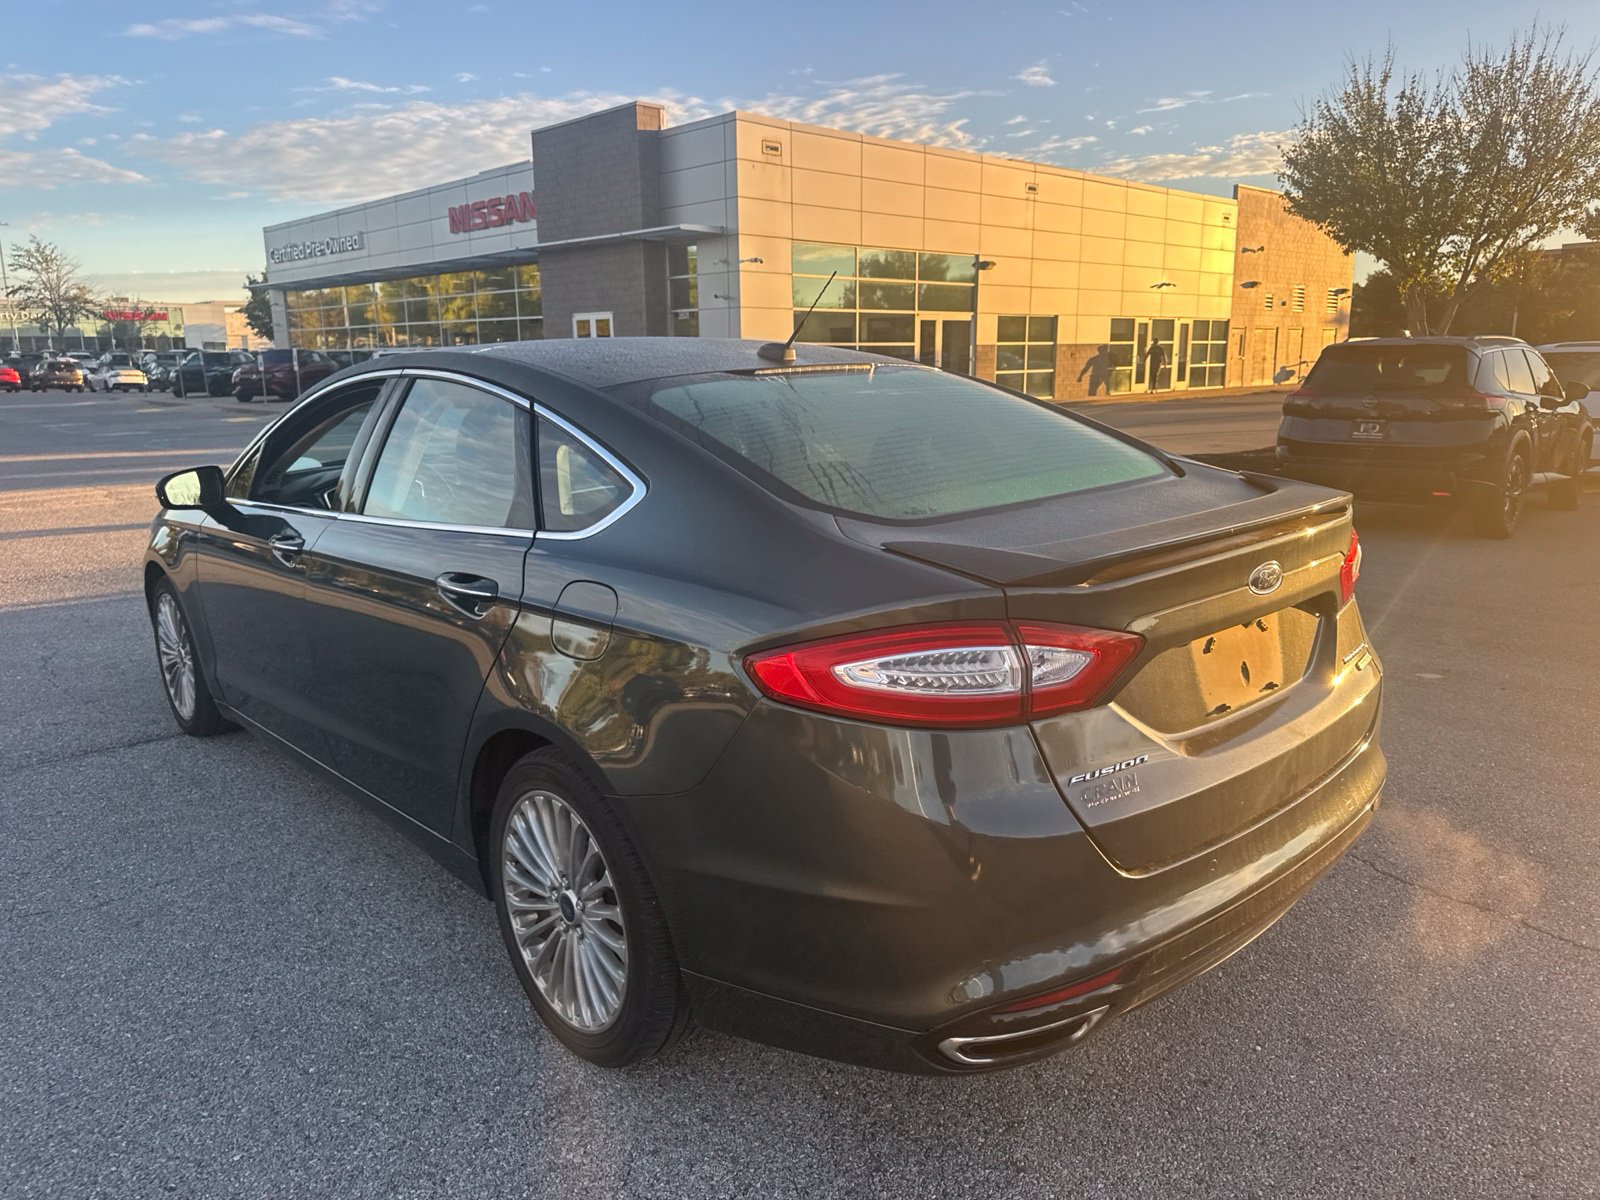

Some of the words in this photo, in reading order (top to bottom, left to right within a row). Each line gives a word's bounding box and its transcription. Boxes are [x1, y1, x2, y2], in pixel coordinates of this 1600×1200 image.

[448, 191, 536, 234] NISSAN
[269, 243, 304, 263] Certified
[305, 233, 360, 257] Pre-Owned
[1067, 754, 1149, 787] FUSION
